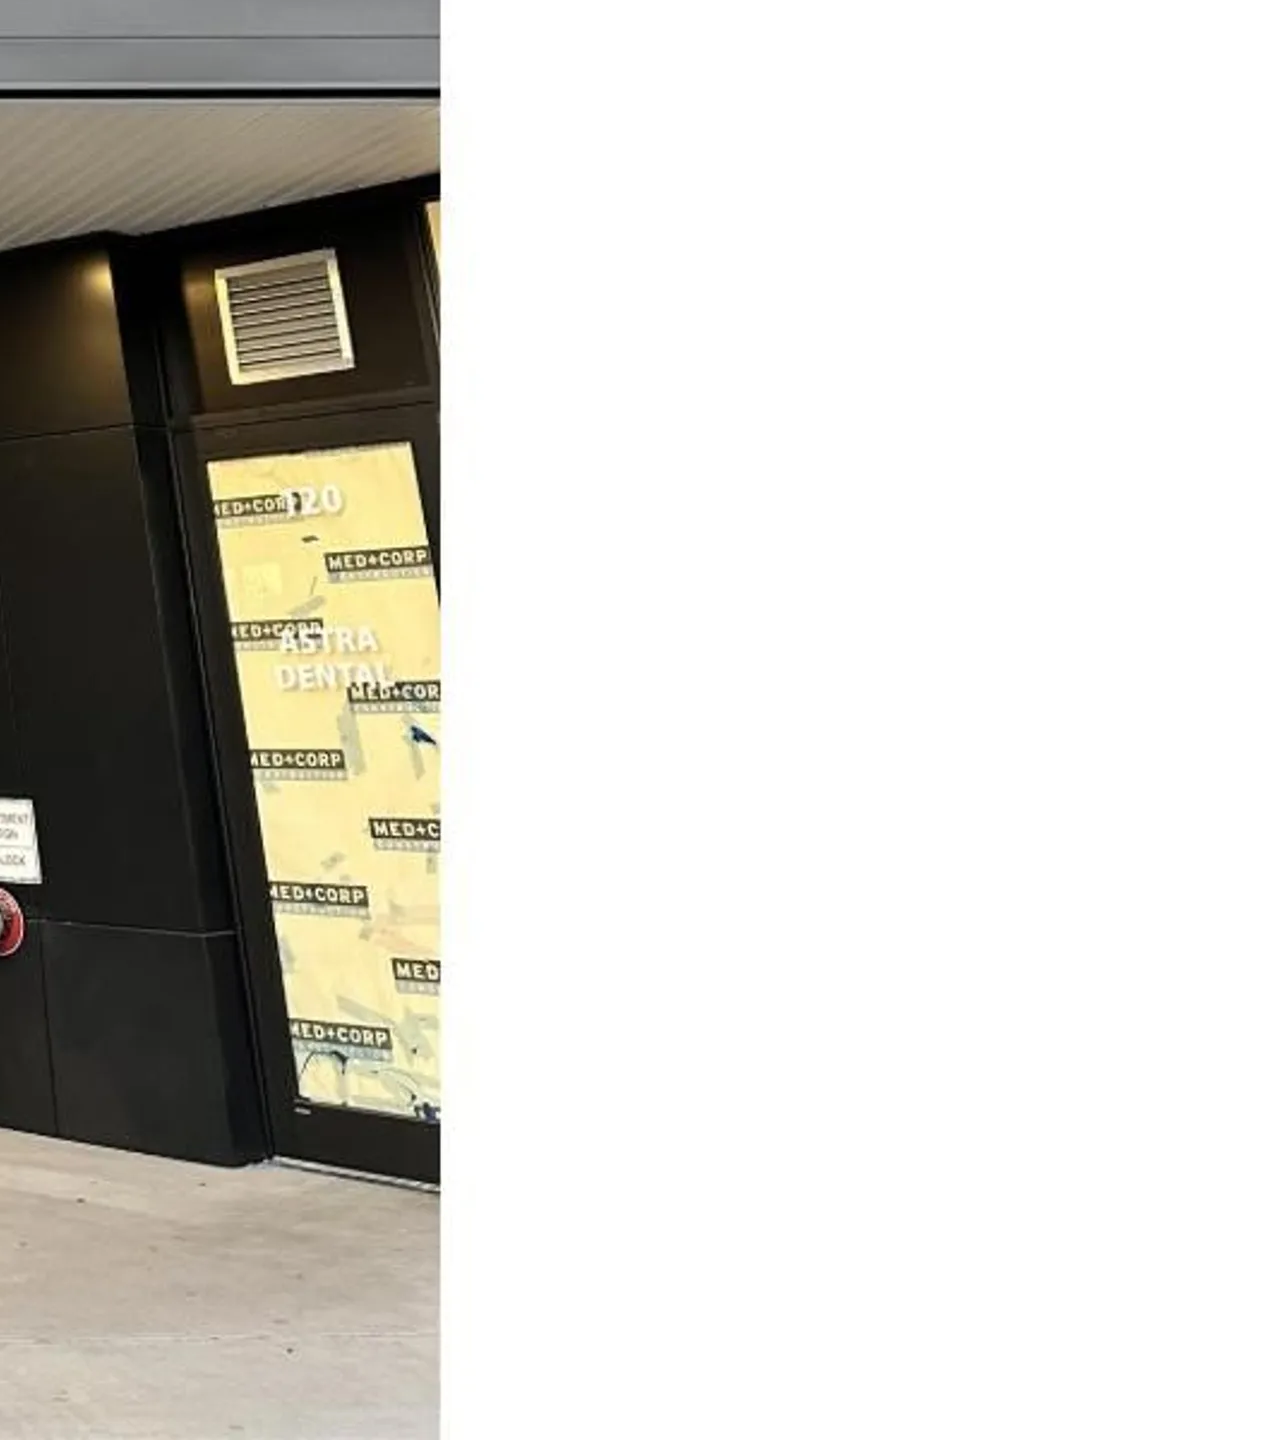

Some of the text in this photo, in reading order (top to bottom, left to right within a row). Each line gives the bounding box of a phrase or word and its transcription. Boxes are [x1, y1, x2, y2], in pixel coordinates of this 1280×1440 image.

[283, 485, 342, 516] 120
[328, 549, 428, 569] MED+CORP
[281, 626, 378, 654] ASTRA
[277, 662, 394, 690] DENTAL
